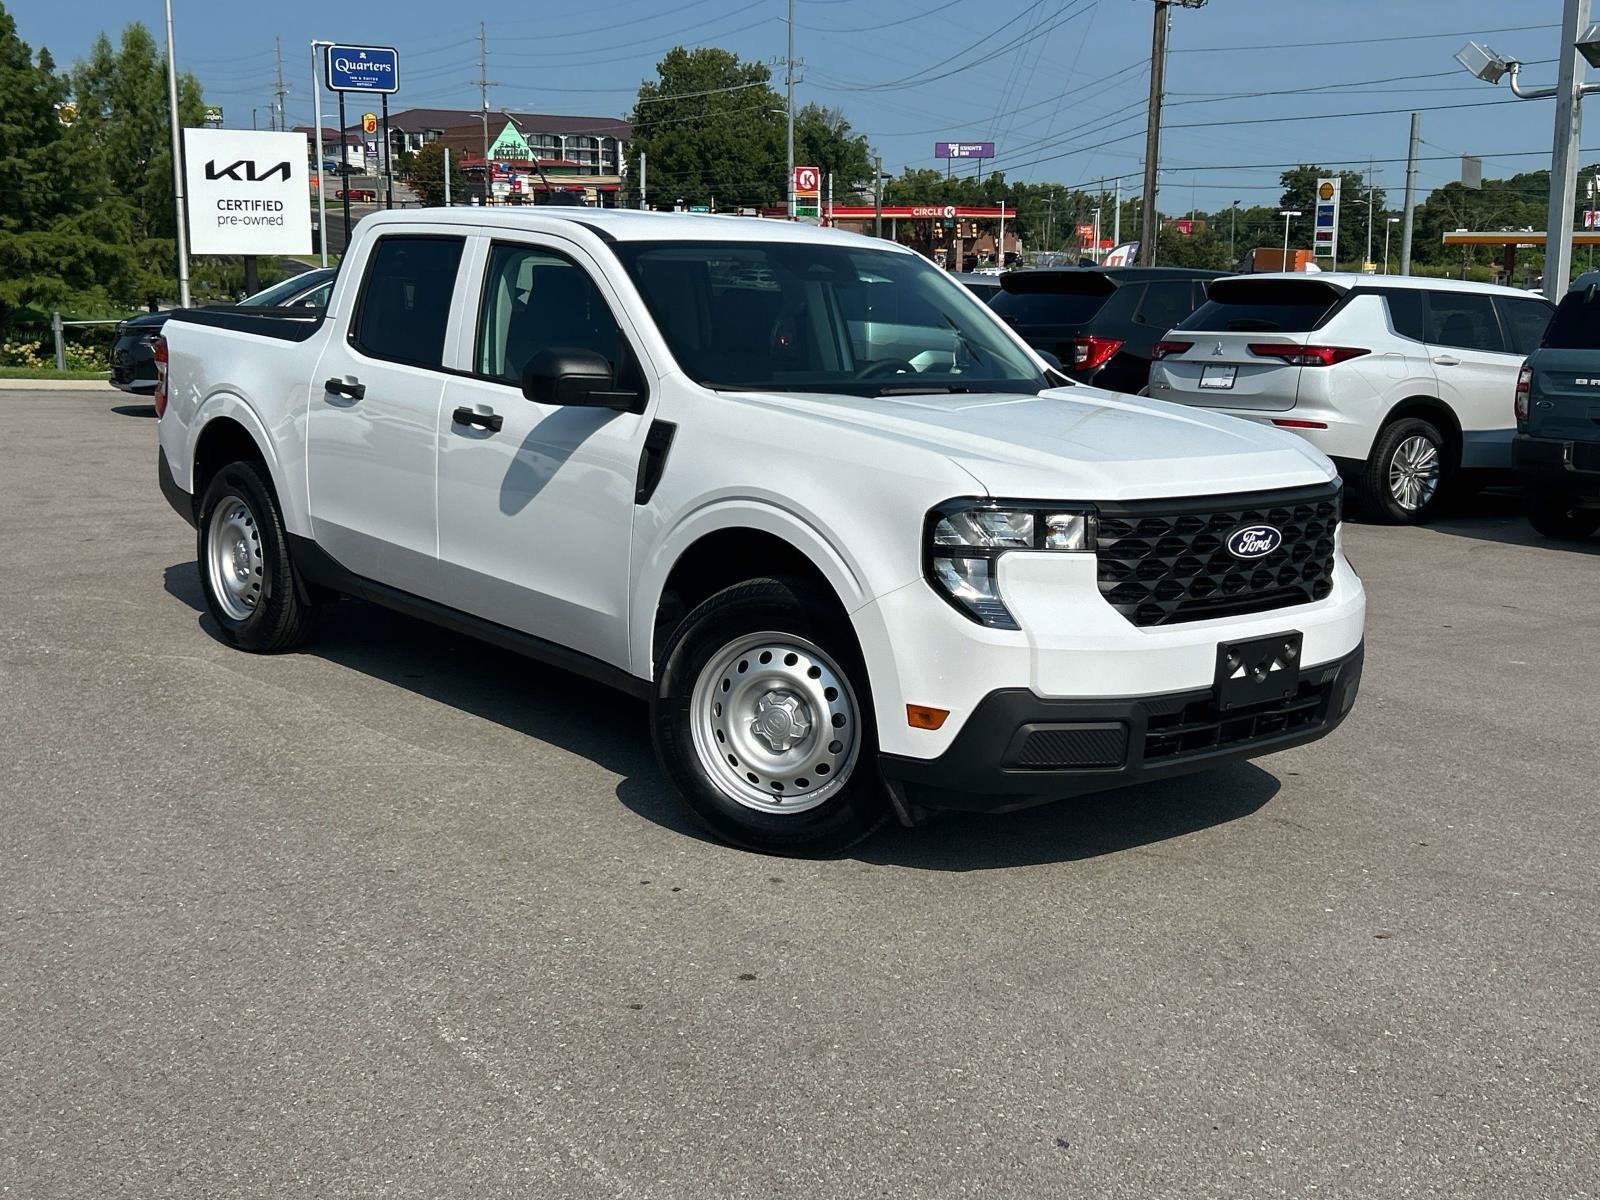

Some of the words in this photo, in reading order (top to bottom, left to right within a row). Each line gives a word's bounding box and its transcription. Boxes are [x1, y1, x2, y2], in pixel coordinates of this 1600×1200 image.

[335, 57, 391, 74] Quarters
[367, 120, 376, 132] 8
[205, 159, 291, 182] KIA
[803, 173, 814, 188] K
[217, 199, 283, 211] CERTIFIED
[912, 208, 943, 216] CIRCLE
[946, 208, 954, 217] K
[217, 214, 284, 227] pre-owned
[1238, 530, 1273, 553] Ford
